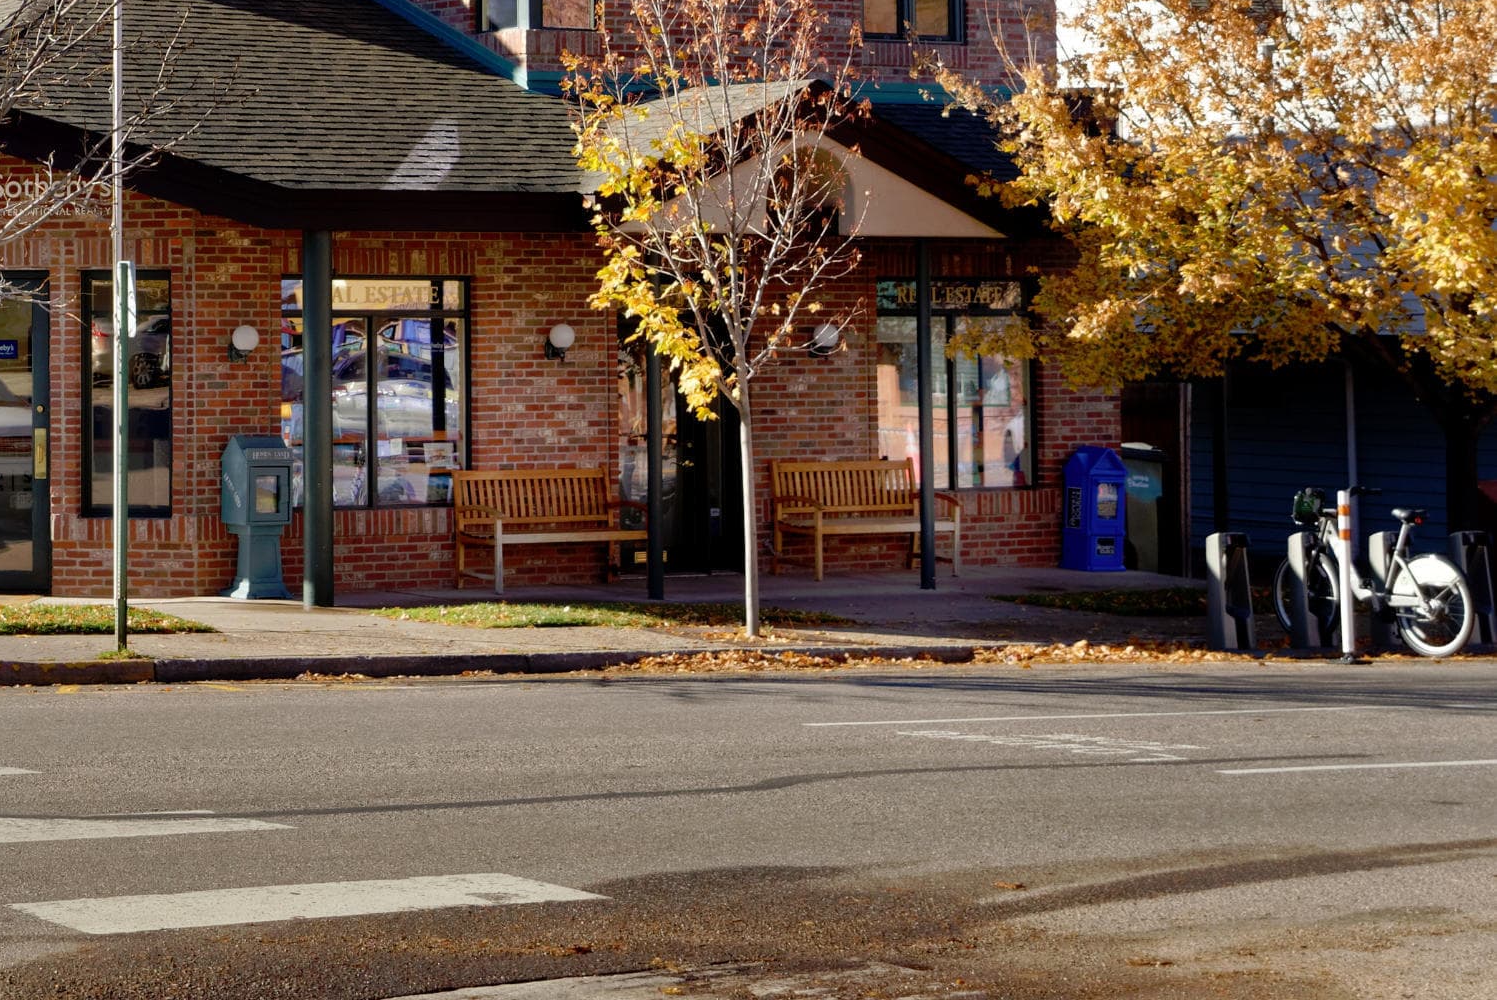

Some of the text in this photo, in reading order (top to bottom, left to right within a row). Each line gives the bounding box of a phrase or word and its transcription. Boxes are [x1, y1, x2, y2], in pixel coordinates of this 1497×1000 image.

[333, 286, 440, 304] AL ESTATE
[896, 286, 1003, 304] REL ESTATE
